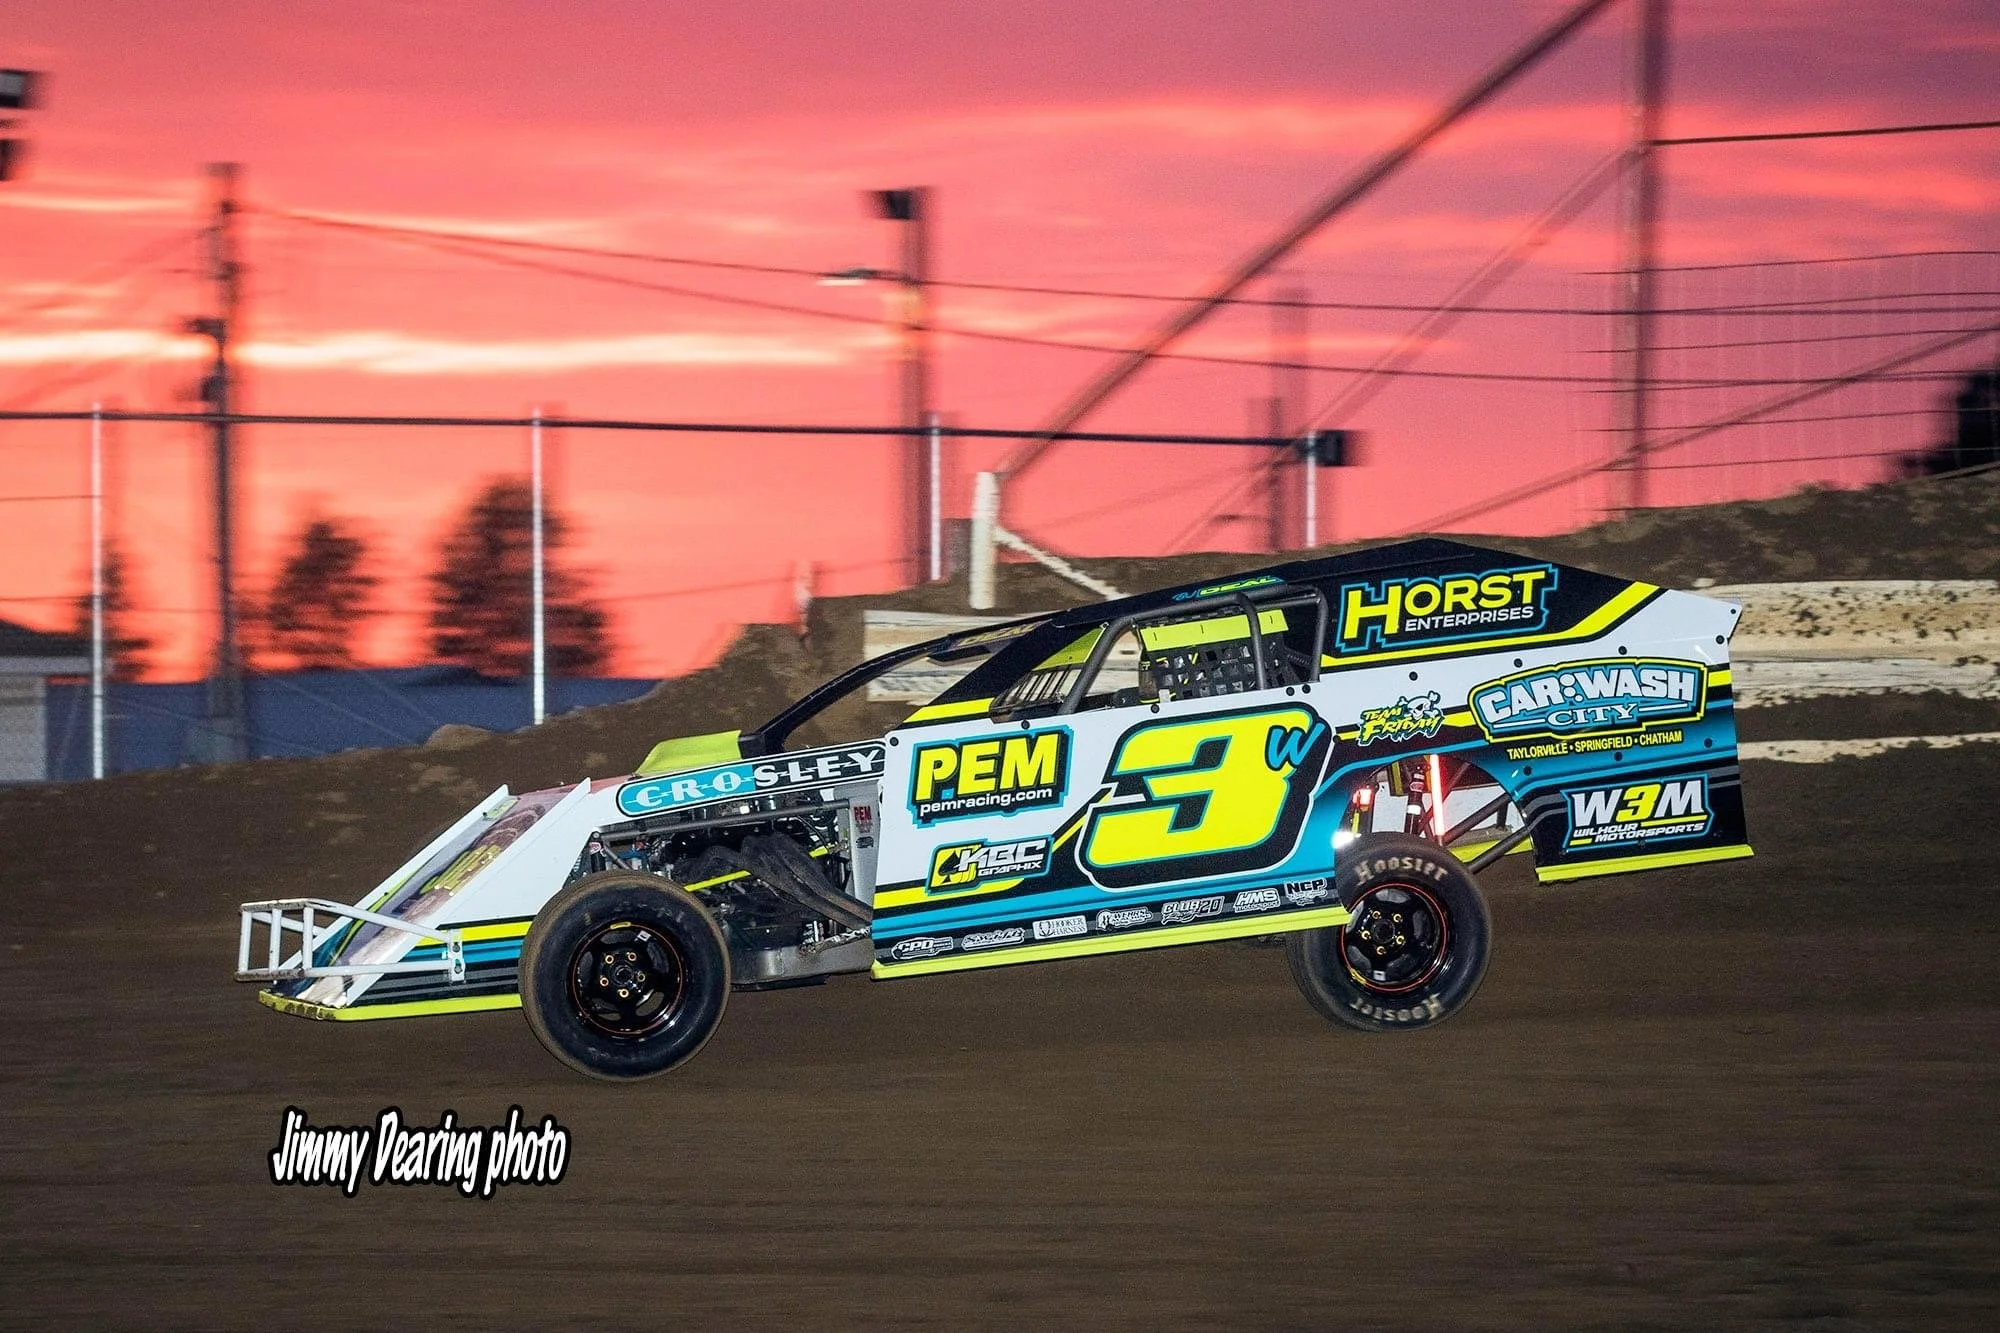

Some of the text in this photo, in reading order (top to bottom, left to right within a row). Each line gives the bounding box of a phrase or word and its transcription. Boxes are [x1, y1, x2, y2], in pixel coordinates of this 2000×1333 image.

[1344, 571, 1546, 640] HORST
[1405, 606, 1534, 632] ENTERPRISES
[1478, 669, 1695, 723] CAR WASH
[1364, 707, 1402, 720] TEAM
[1547, 703, 1638, 726] CITY
[1507, 730, 1682, 760] TAYLORVILLE SPRINGFIELD CHATHAM
[635, 750, 881, 806] CROSLEY
[915, 733, 1059, 801] PEM
[920, 788, 1053, 817] pemracing.com
[1572, 780, 1705, 827] W3M
[1573, 822, 1639, 838] WILHOUR
[1594, 822, 1705, 843] MOTORSPORTS
[957, 839, 1047, 872] KBC
[977, 861, 1043, 877] GRAPHIX
[1163, 899, 1199, 914] CLUB
[1236, 890, 1277, 906] HMS
